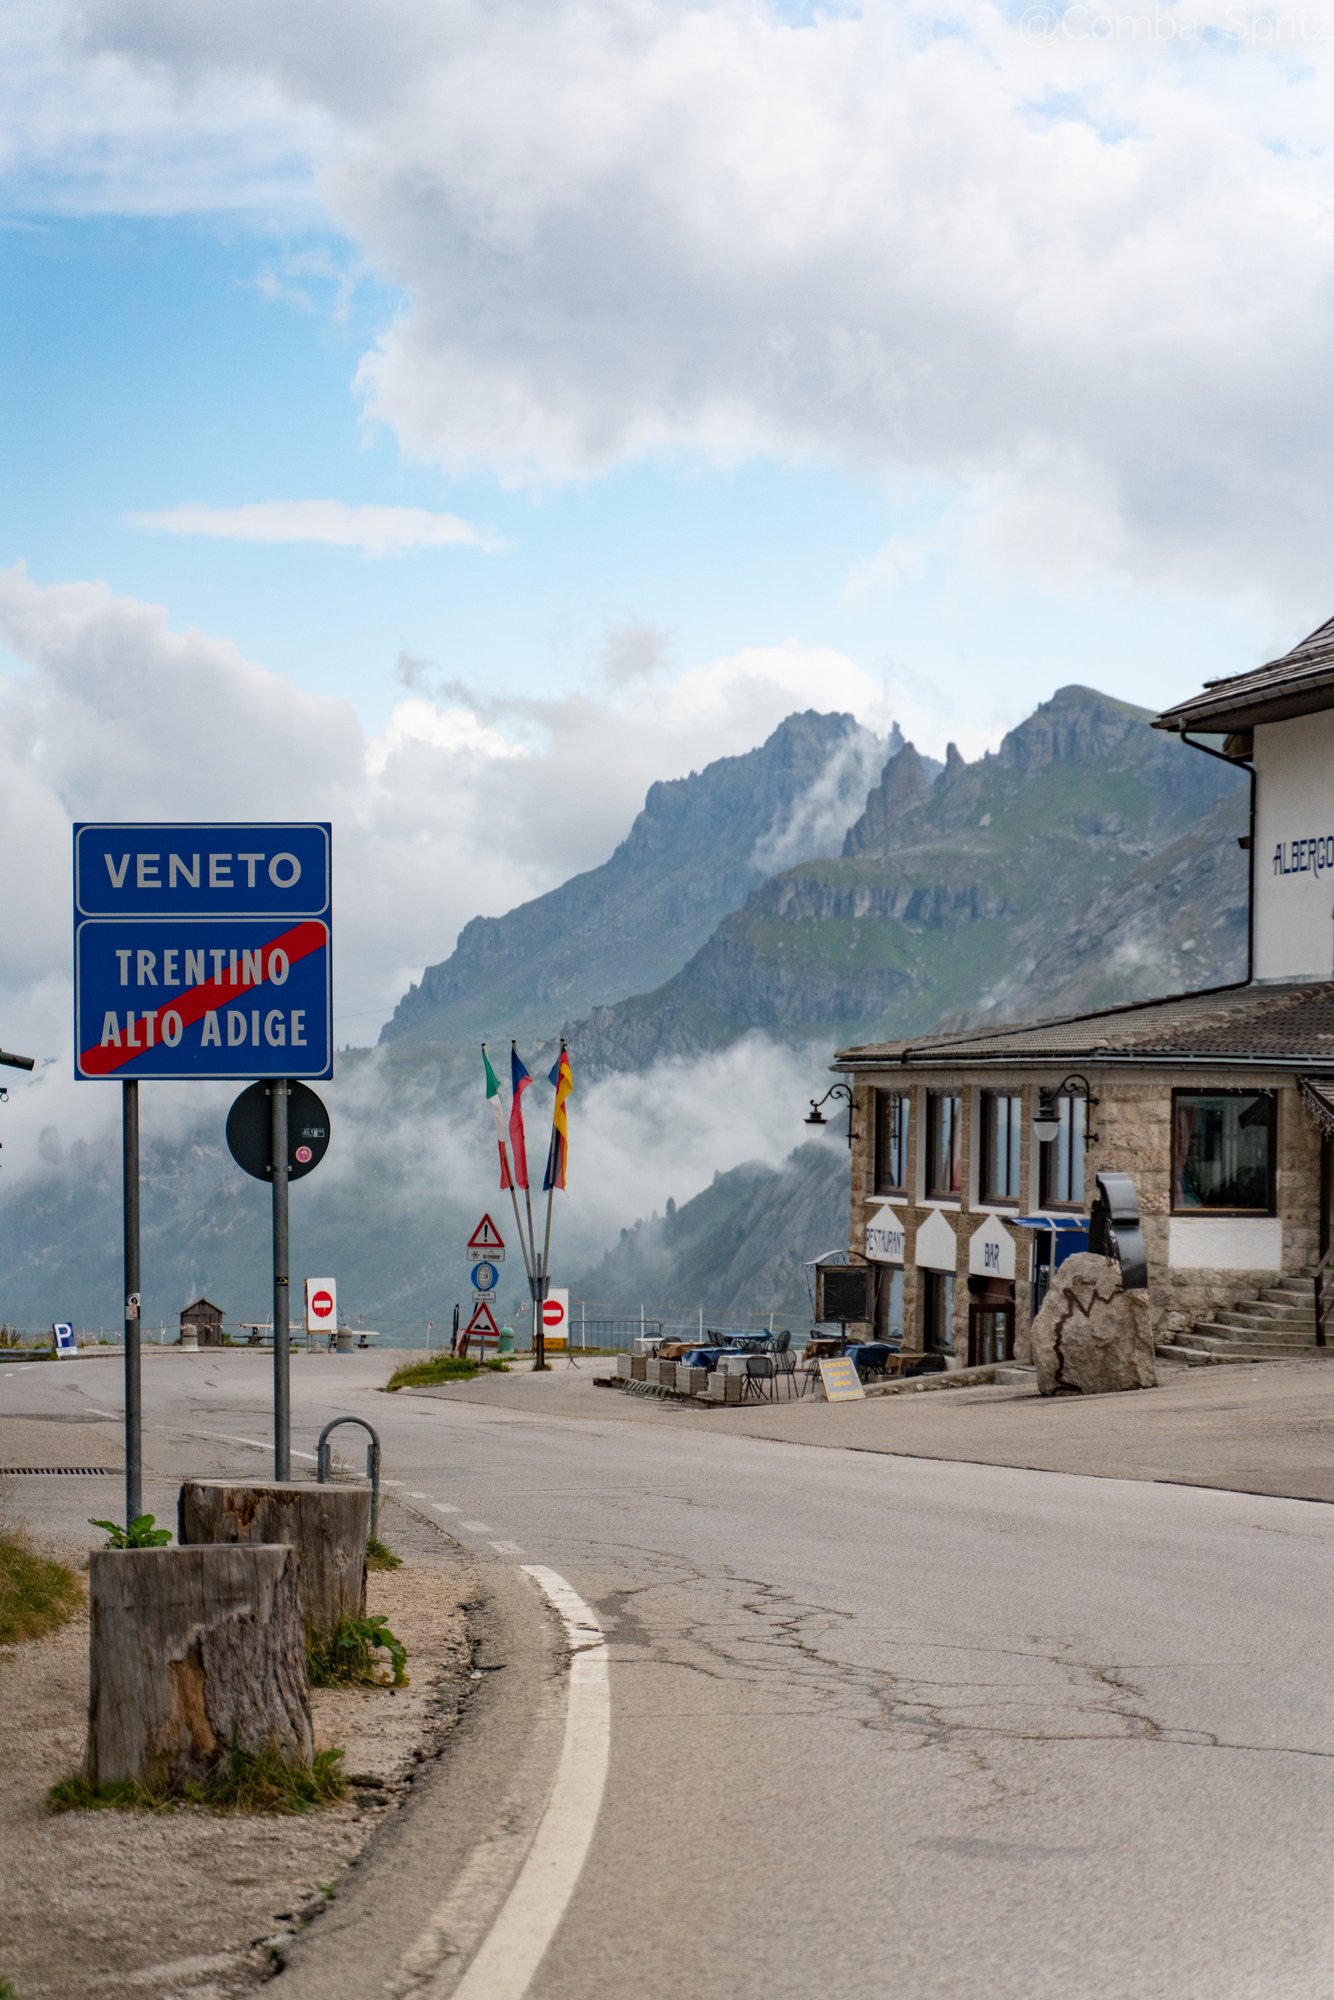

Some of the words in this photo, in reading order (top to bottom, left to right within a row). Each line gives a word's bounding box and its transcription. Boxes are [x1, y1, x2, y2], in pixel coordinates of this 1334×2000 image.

[104, 852, 302, 888] VENETO
[1272, 835, 1334, 879] ALBERGO
[115, 947, 290, 986] TRENTINO
[100, 1010, 184, 1048] ALTO
[200, 1009, 308, 1047] ADIGE
[984, 1242, 1000, 1274] BAR
[54, 1323, 71, 1348] P
